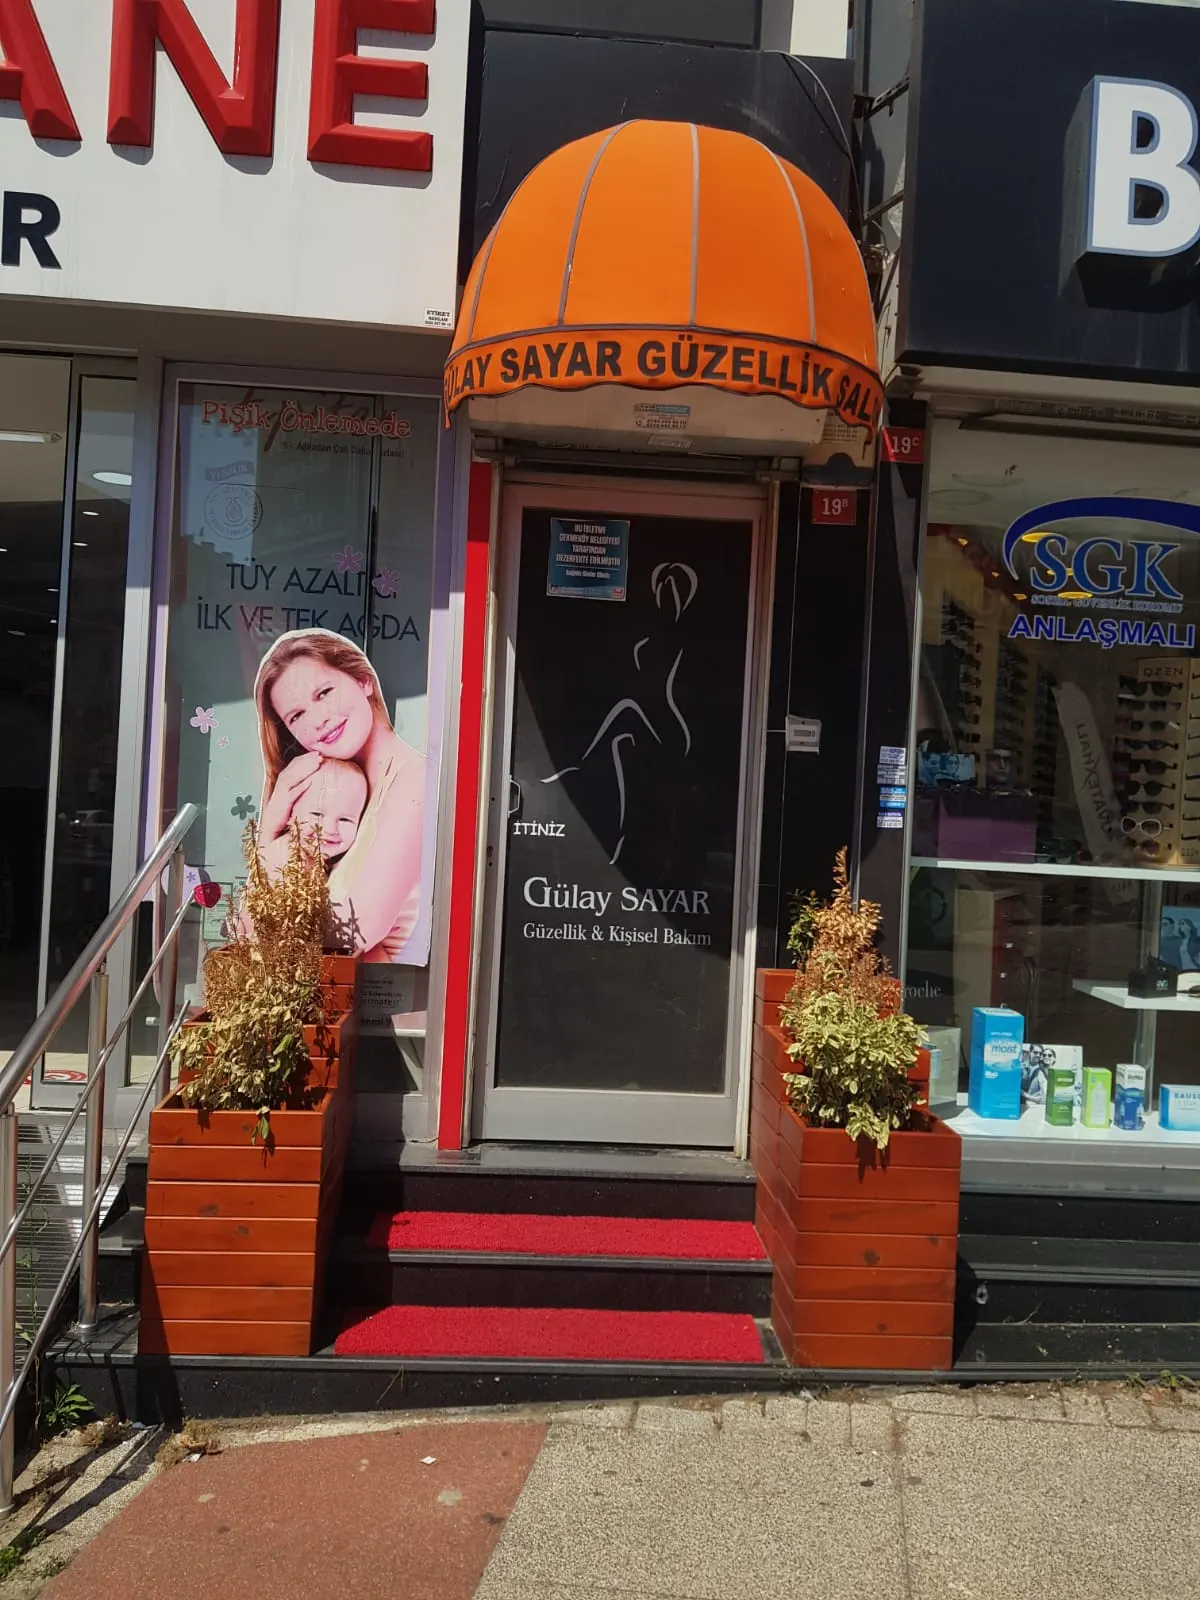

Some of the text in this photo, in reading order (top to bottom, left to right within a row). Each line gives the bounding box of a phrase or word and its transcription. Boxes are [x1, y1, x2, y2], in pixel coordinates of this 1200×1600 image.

[1087, 75, 1200, 258] B
[1, 190, 62, 270] R
[444, 334, 880, 422] ÜLAY SAYAR GÜZELLİK SAL
[201, 399, 413, 440] Pişik Önlemede
[226, 557, 278, 591] TÜY
[1030, 532, 1184, 600] SGK
[197, 596, 232, 631] İLK
[239, 604, 273, 633] VE
[281, 606, 329, 633] TEK
[1008, 613, 1196, 649] ANLAŞMALI
[513, 819, 566, 837] İTİNİZ
[523, 876, 711, 917] Gülay SAYAR
[523, 922, 712, 947] Güzellik & Kişisel Bakım
